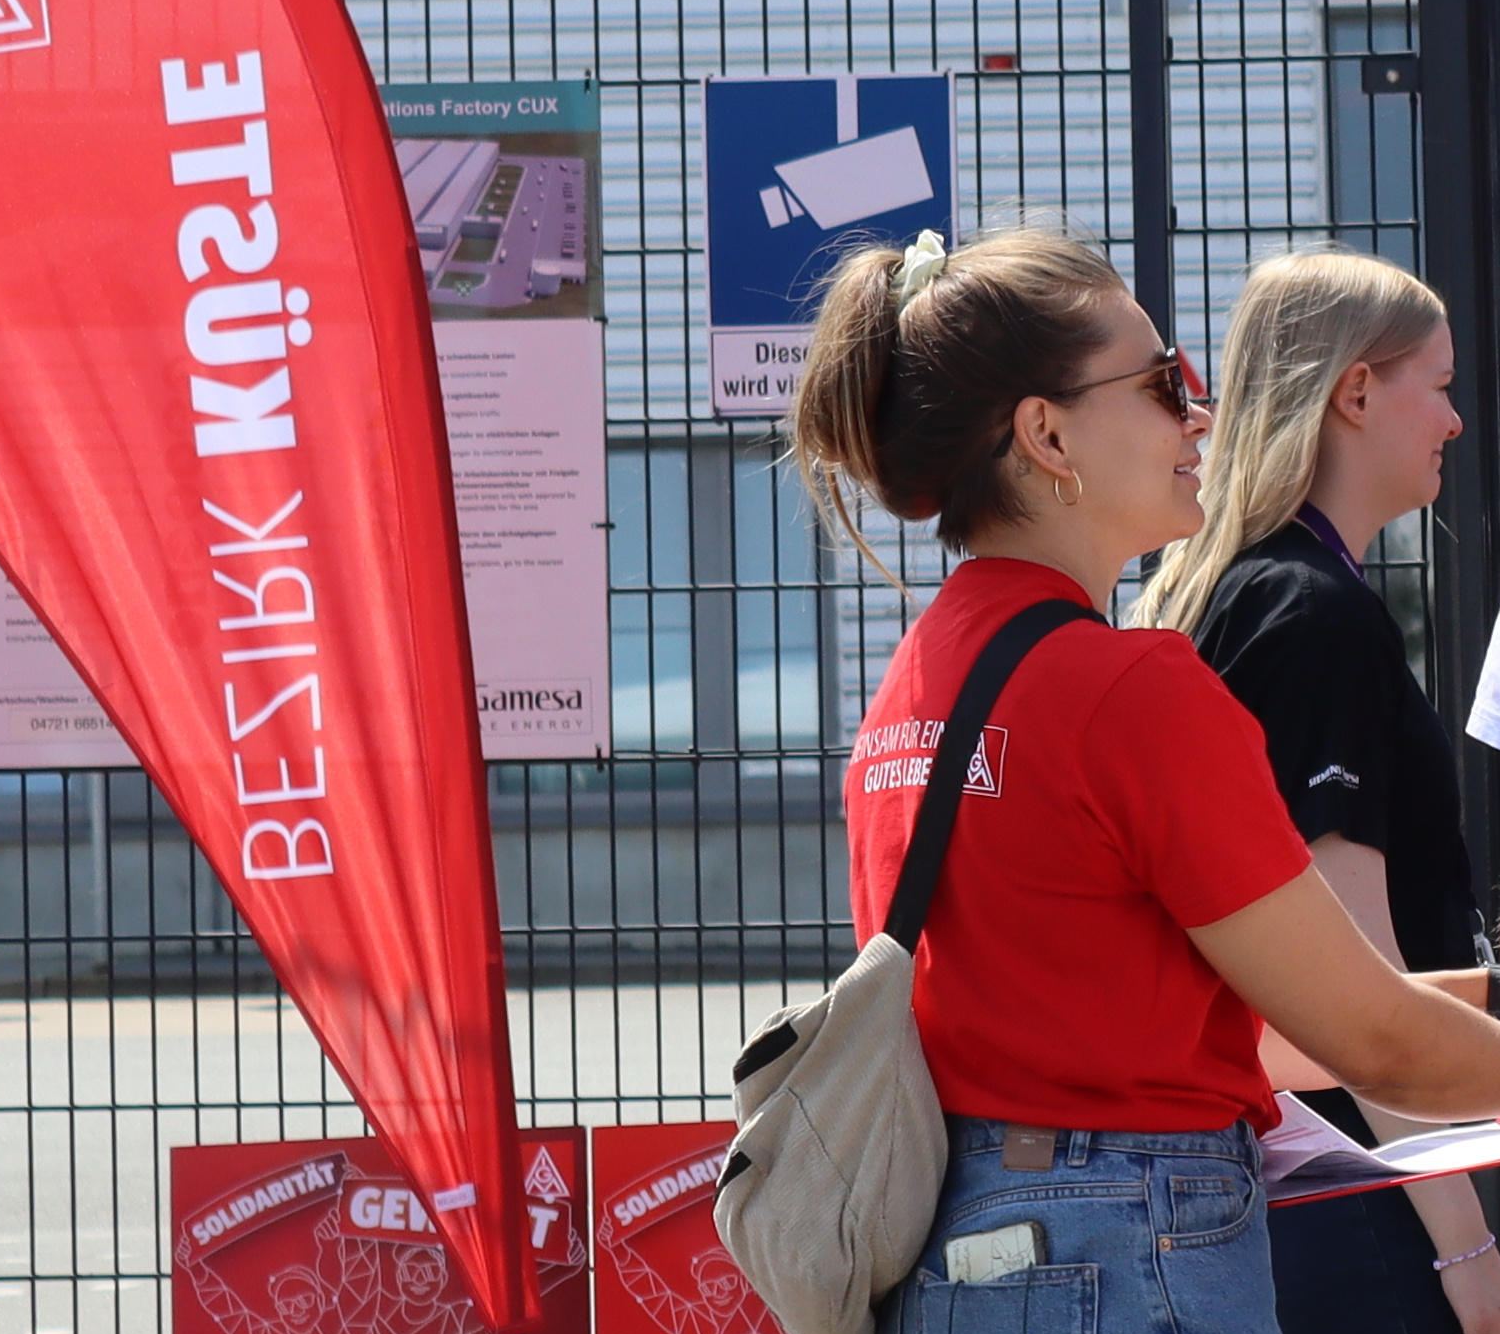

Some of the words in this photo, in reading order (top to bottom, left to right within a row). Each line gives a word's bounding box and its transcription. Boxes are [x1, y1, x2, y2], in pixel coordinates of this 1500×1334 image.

[442, 100, 511, 118] Factory
[517, 98, 558, 114] CUX
[722, 374, 768, 397] wird
[30, 719, 69, 731] 04721
[511, 720, 583, 731] ENERGY
[899, 716, 919, 750] FÜR
[864, 759, 901, 794] GUTES
[902, 756, 934, 787] LEBE
[613, 1151, 727, 1227] SOLIDARIT
[191, 1161, 336, 1246] SOLIDARITÄT
